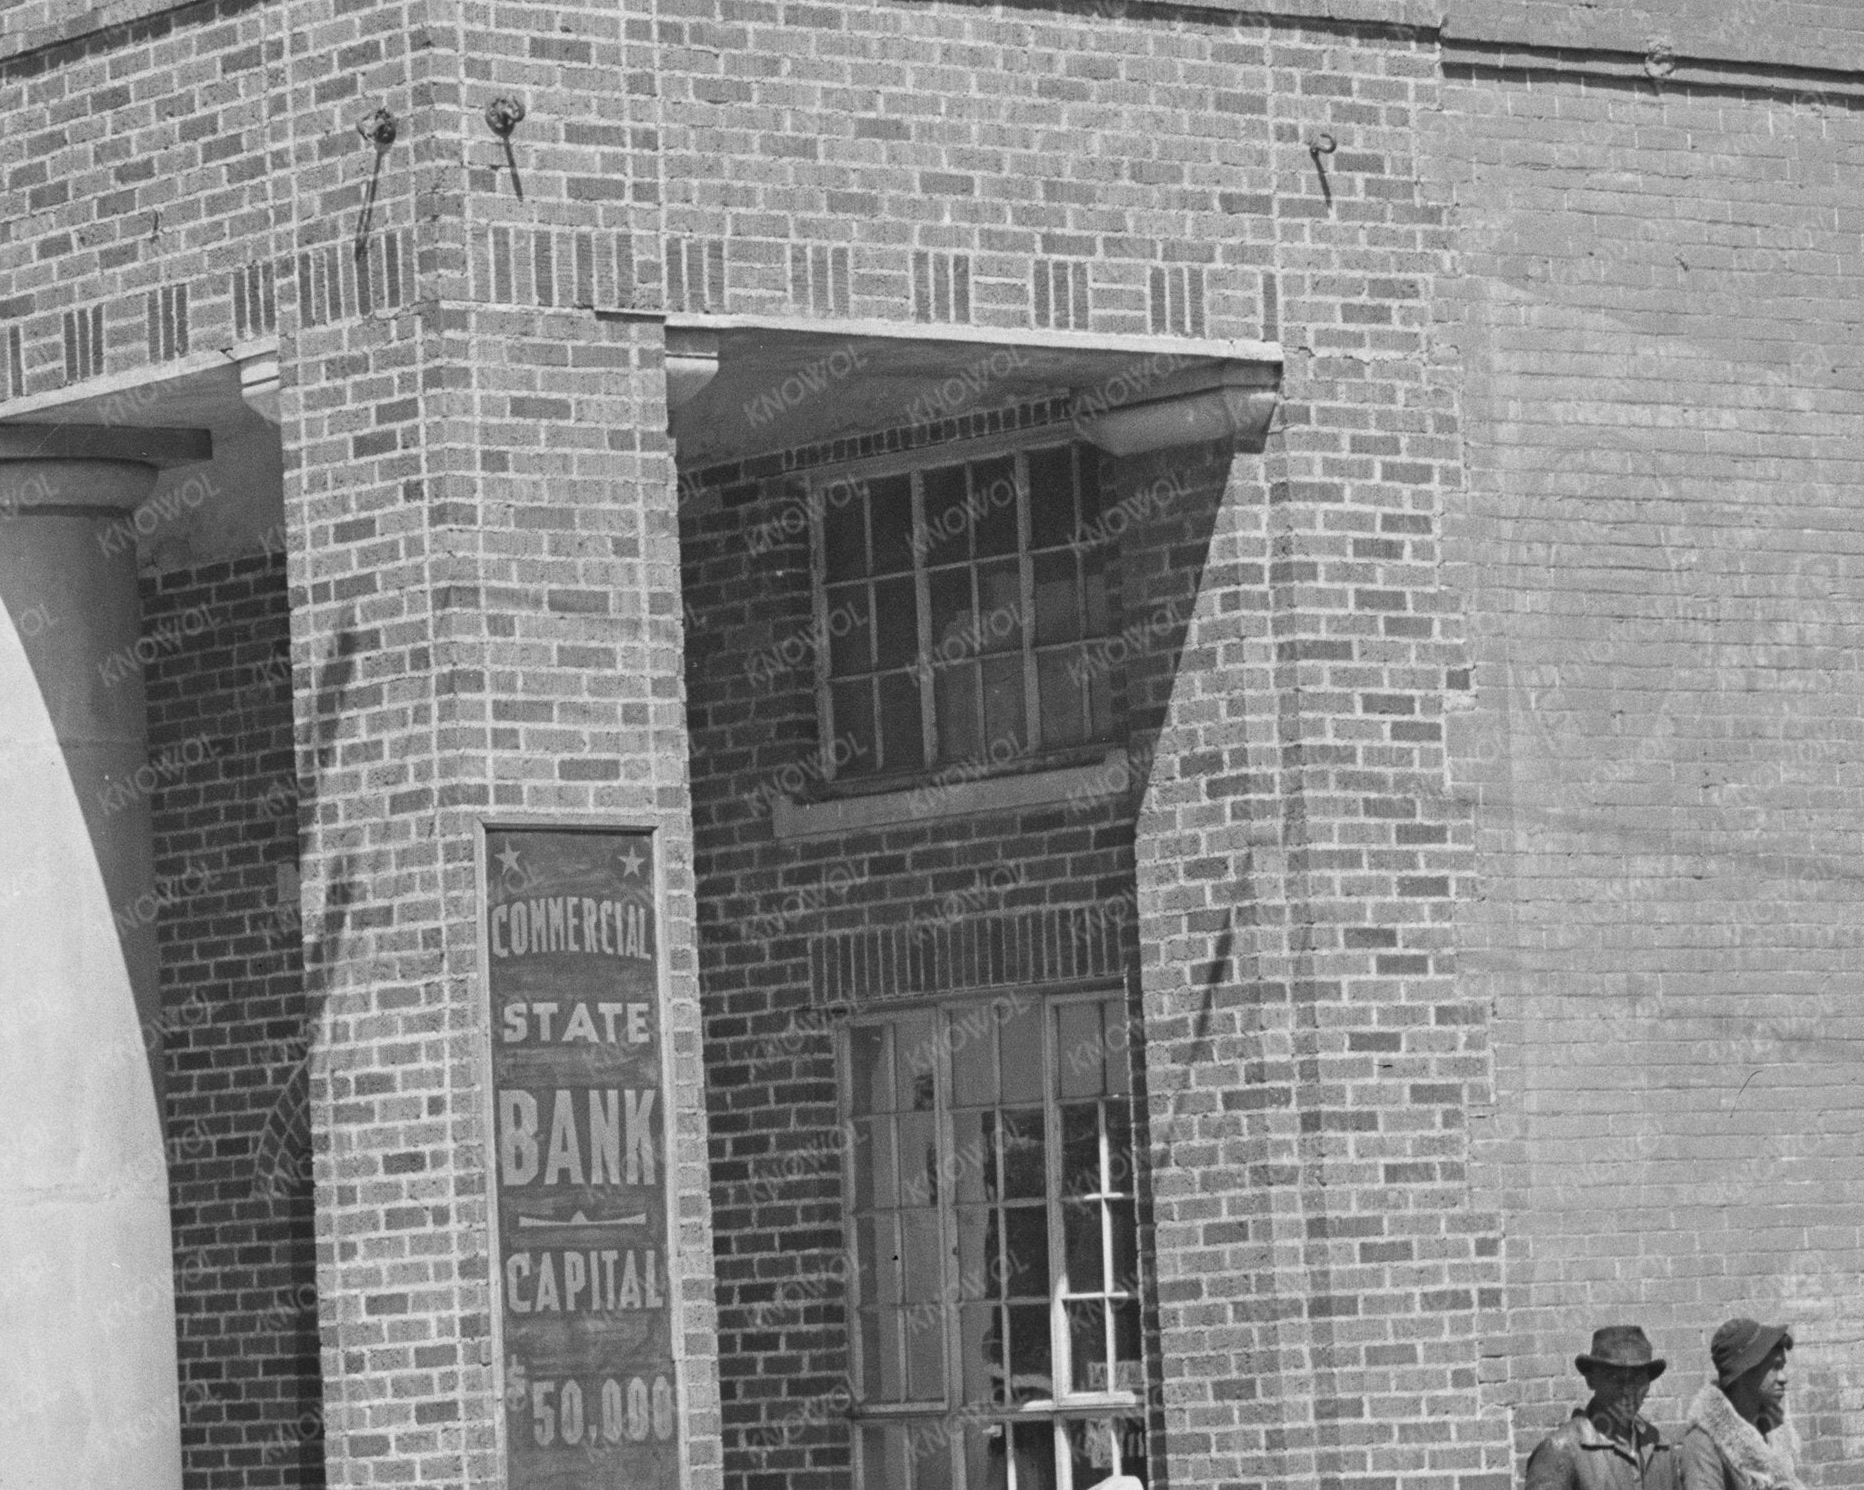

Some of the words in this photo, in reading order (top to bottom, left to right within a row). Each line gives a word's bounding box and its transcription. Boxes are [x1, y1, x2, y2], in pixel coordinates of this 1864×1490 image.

[490, 897, 652, 961] COMMERCIAL
[502, 1002, 650, 1044] STATE
[498, 1089, 657, 1188] BANK
[506, 1248, 664, 1313] CAPITAL
